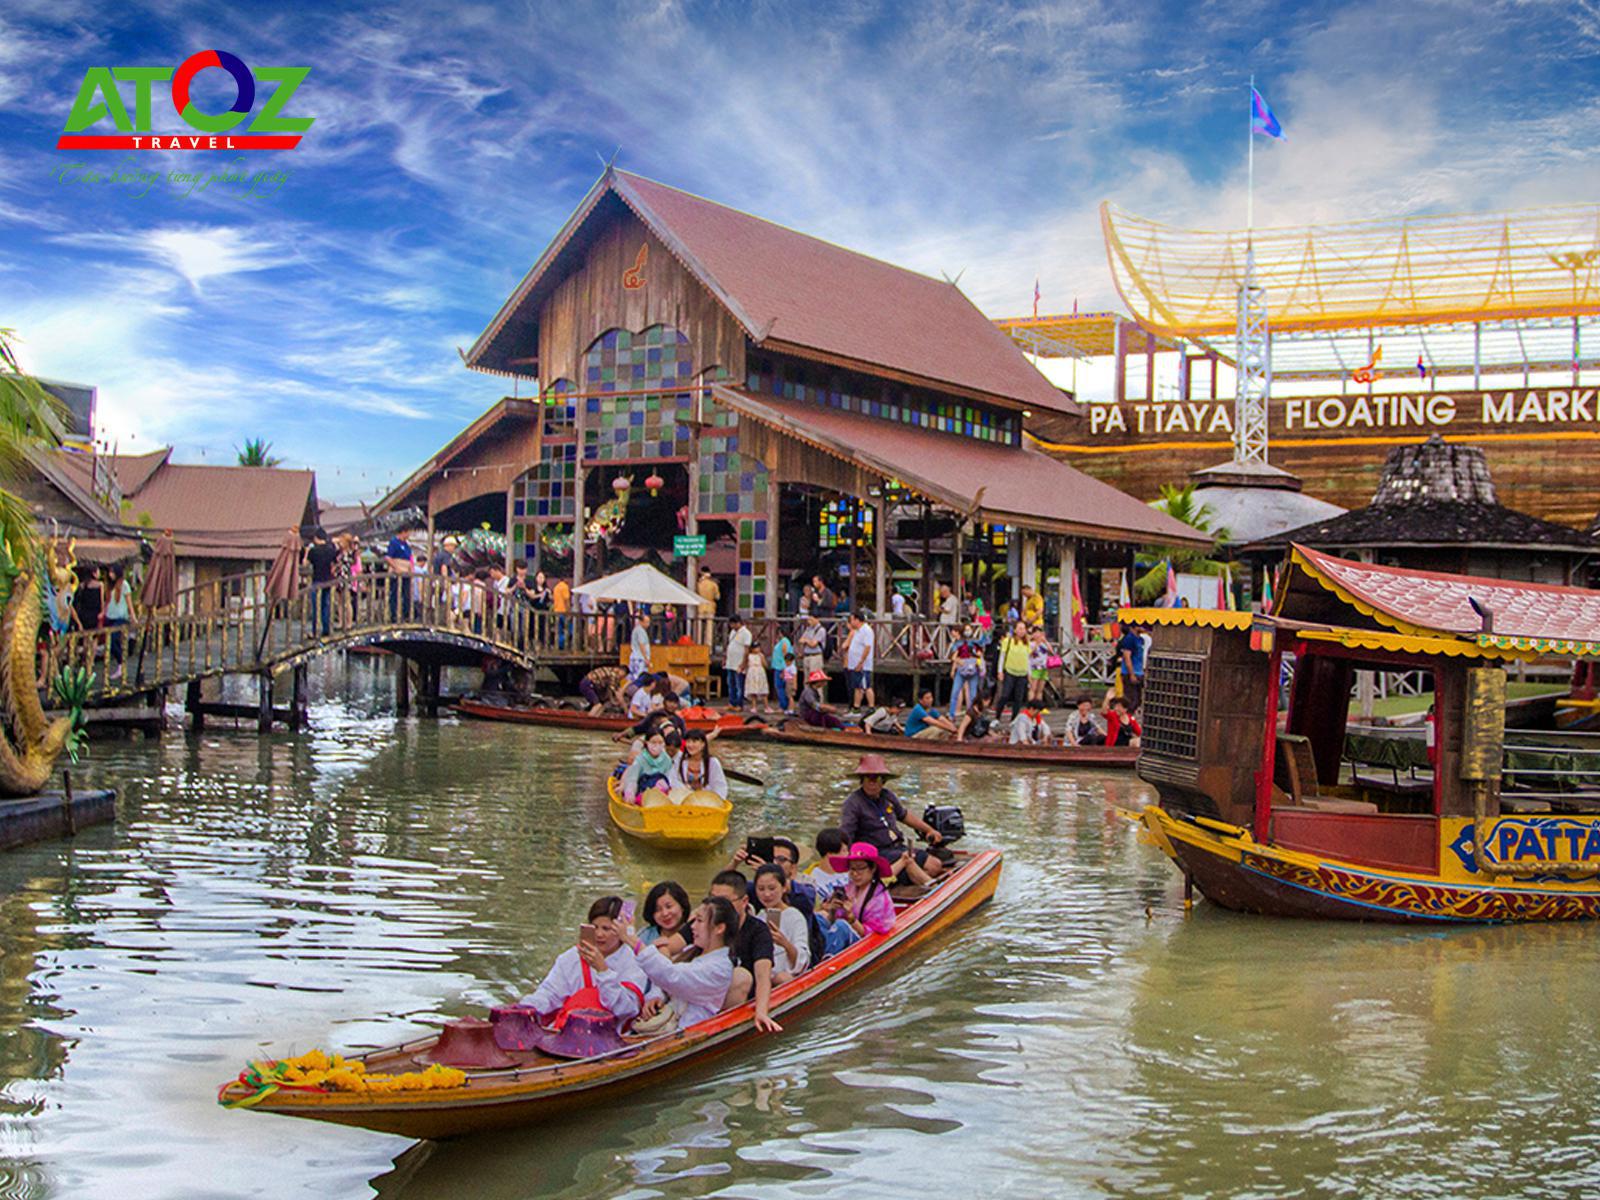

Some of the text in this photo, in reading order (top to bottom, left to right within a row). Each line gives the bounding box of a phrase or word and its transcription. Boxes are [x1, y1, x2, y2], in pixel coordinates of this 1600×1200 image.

[1286, 396, 1456, 429] FLOATING
[1482, 390, 1600, 424] MARK
[1499, 827, 1600, 861] PATTA
